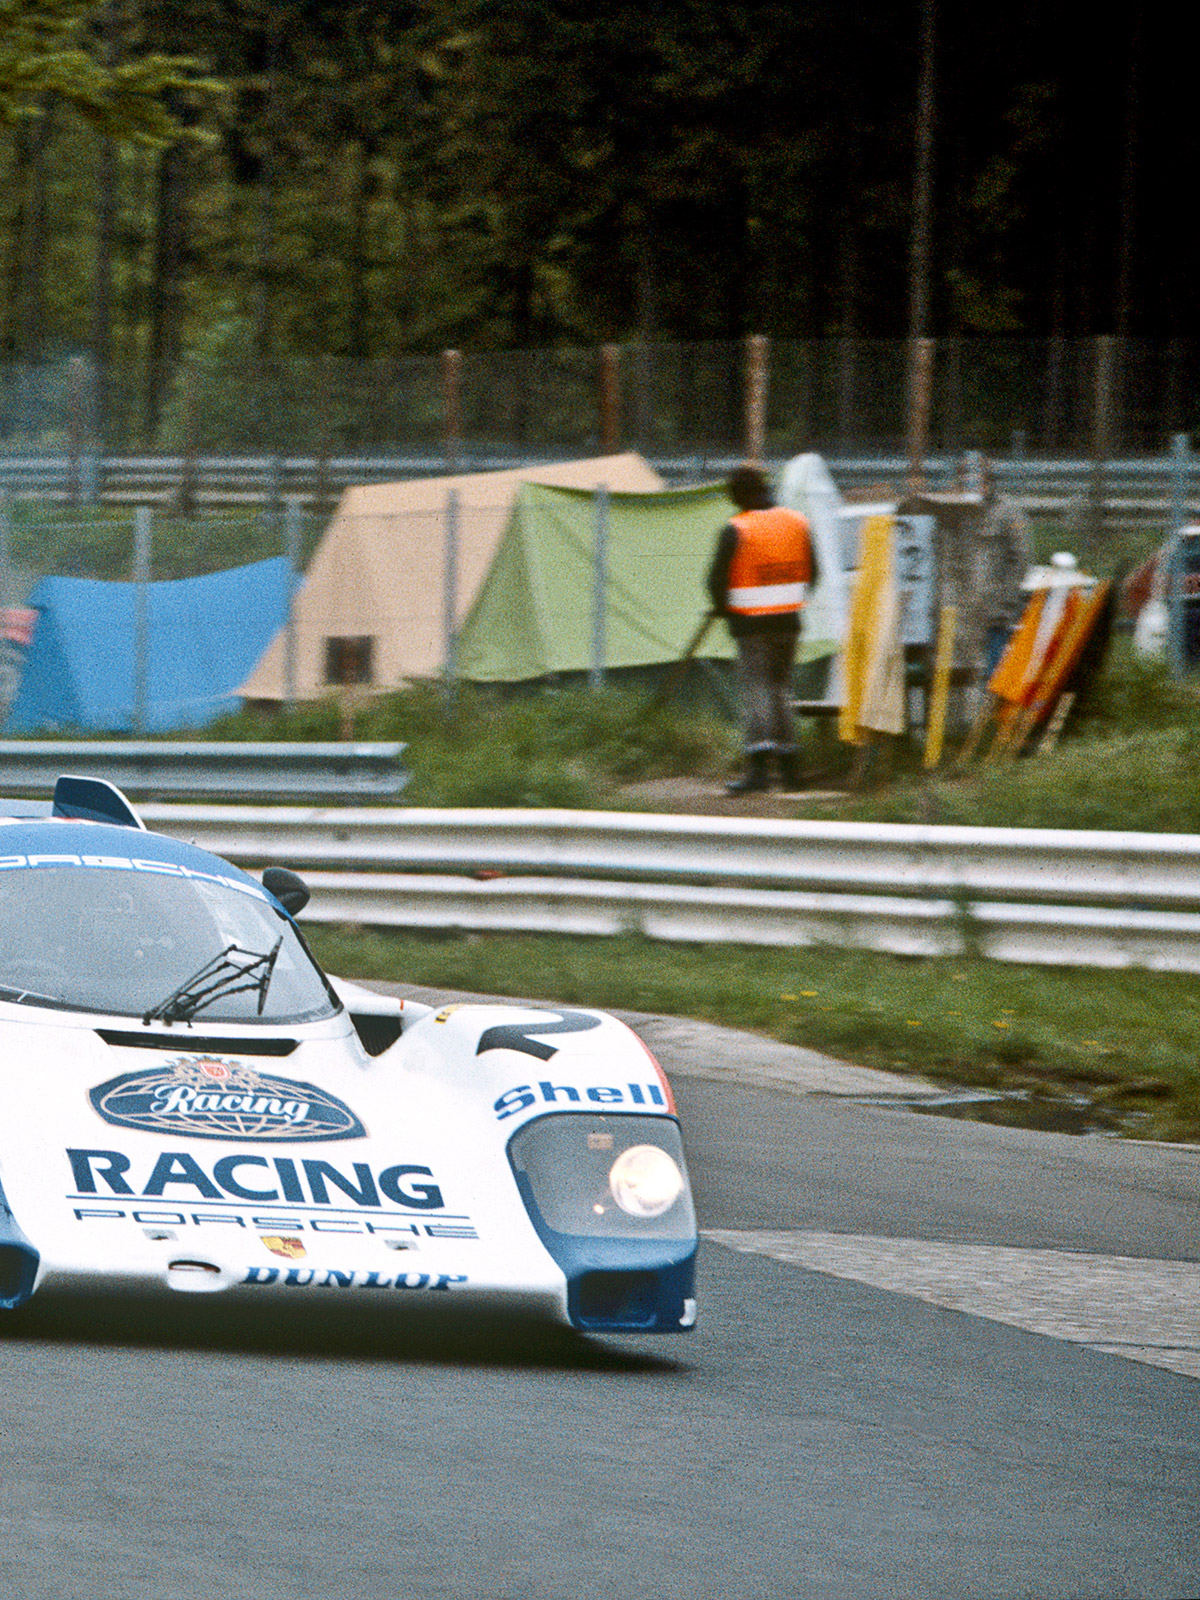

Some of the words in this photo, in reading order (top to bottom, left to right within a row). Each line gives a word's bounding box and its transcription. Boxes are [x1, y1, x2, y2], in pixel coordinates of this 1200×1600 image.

[150, 1085, 310, 1123] Racing
[493, 1081, 665, 1119] Shell
[66, 1148, 445, 1209] RACING
[73, 1208, 479, 1239] PORSCHE
[240, 1266, 469, 1291] DUNLOP
